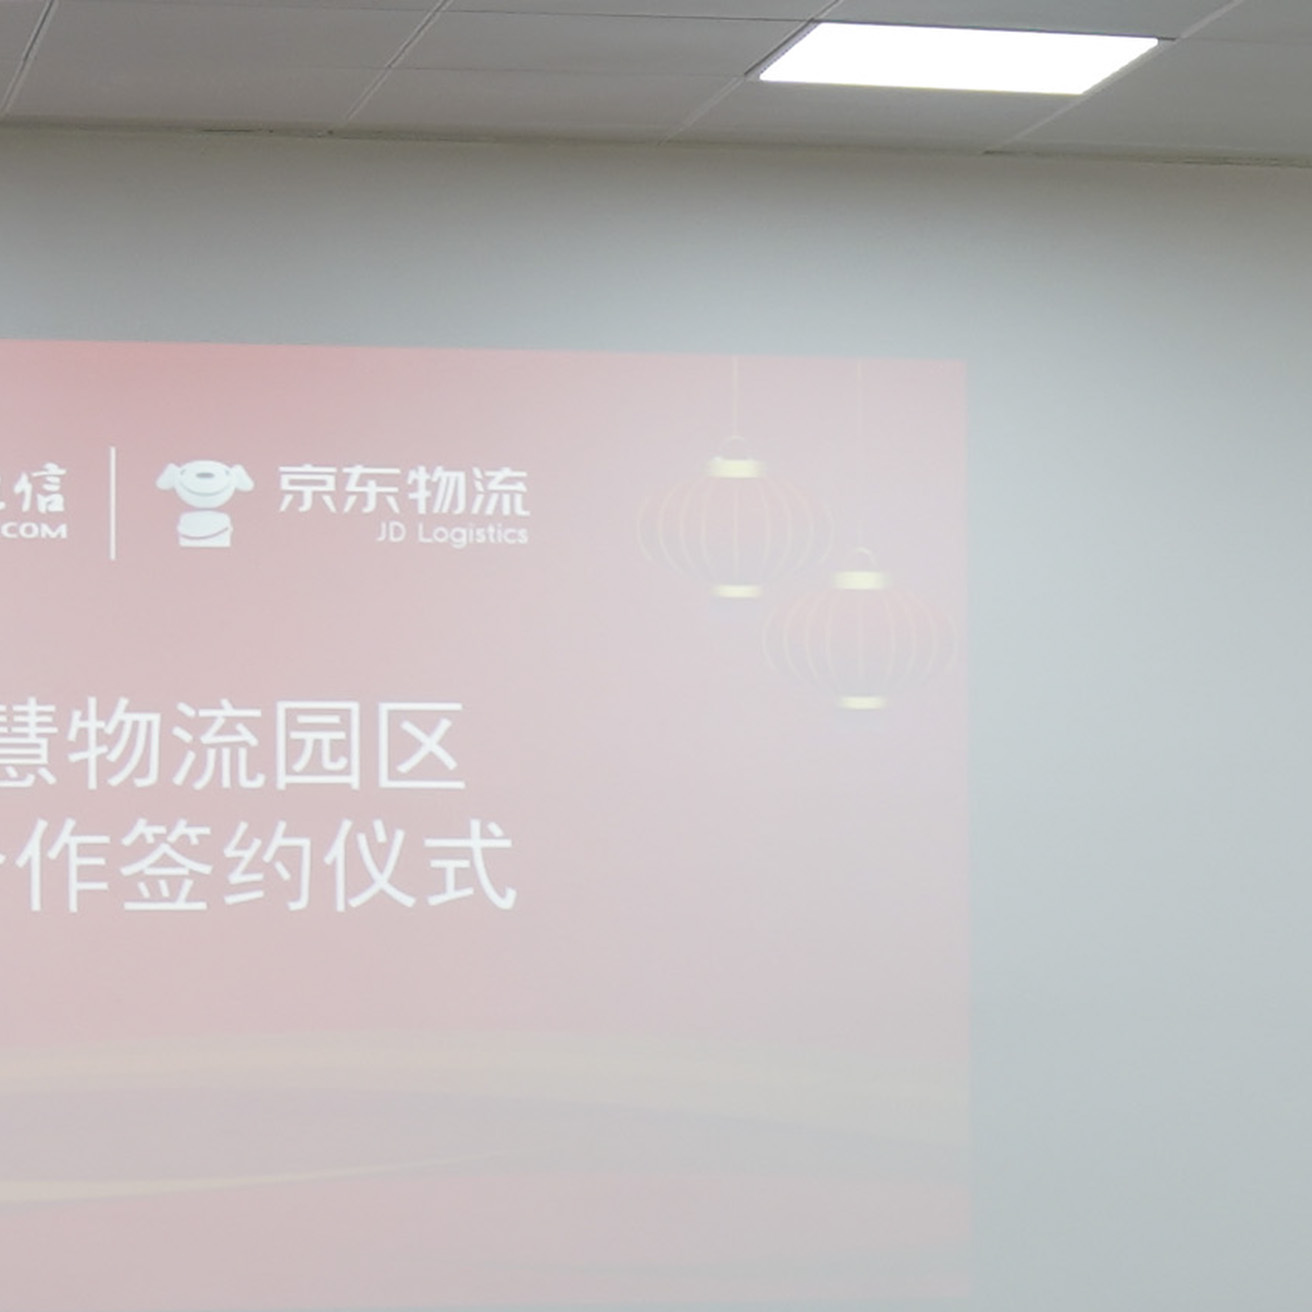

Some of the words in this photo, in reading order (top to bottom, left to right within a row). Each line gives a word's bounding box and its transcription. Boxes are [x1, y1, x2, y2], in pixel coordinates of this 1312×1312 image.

[278, 463, 531, 517] 京东物流
[376, 521, 406, 546] JD
[418, 520, 529, 549] Logistics
